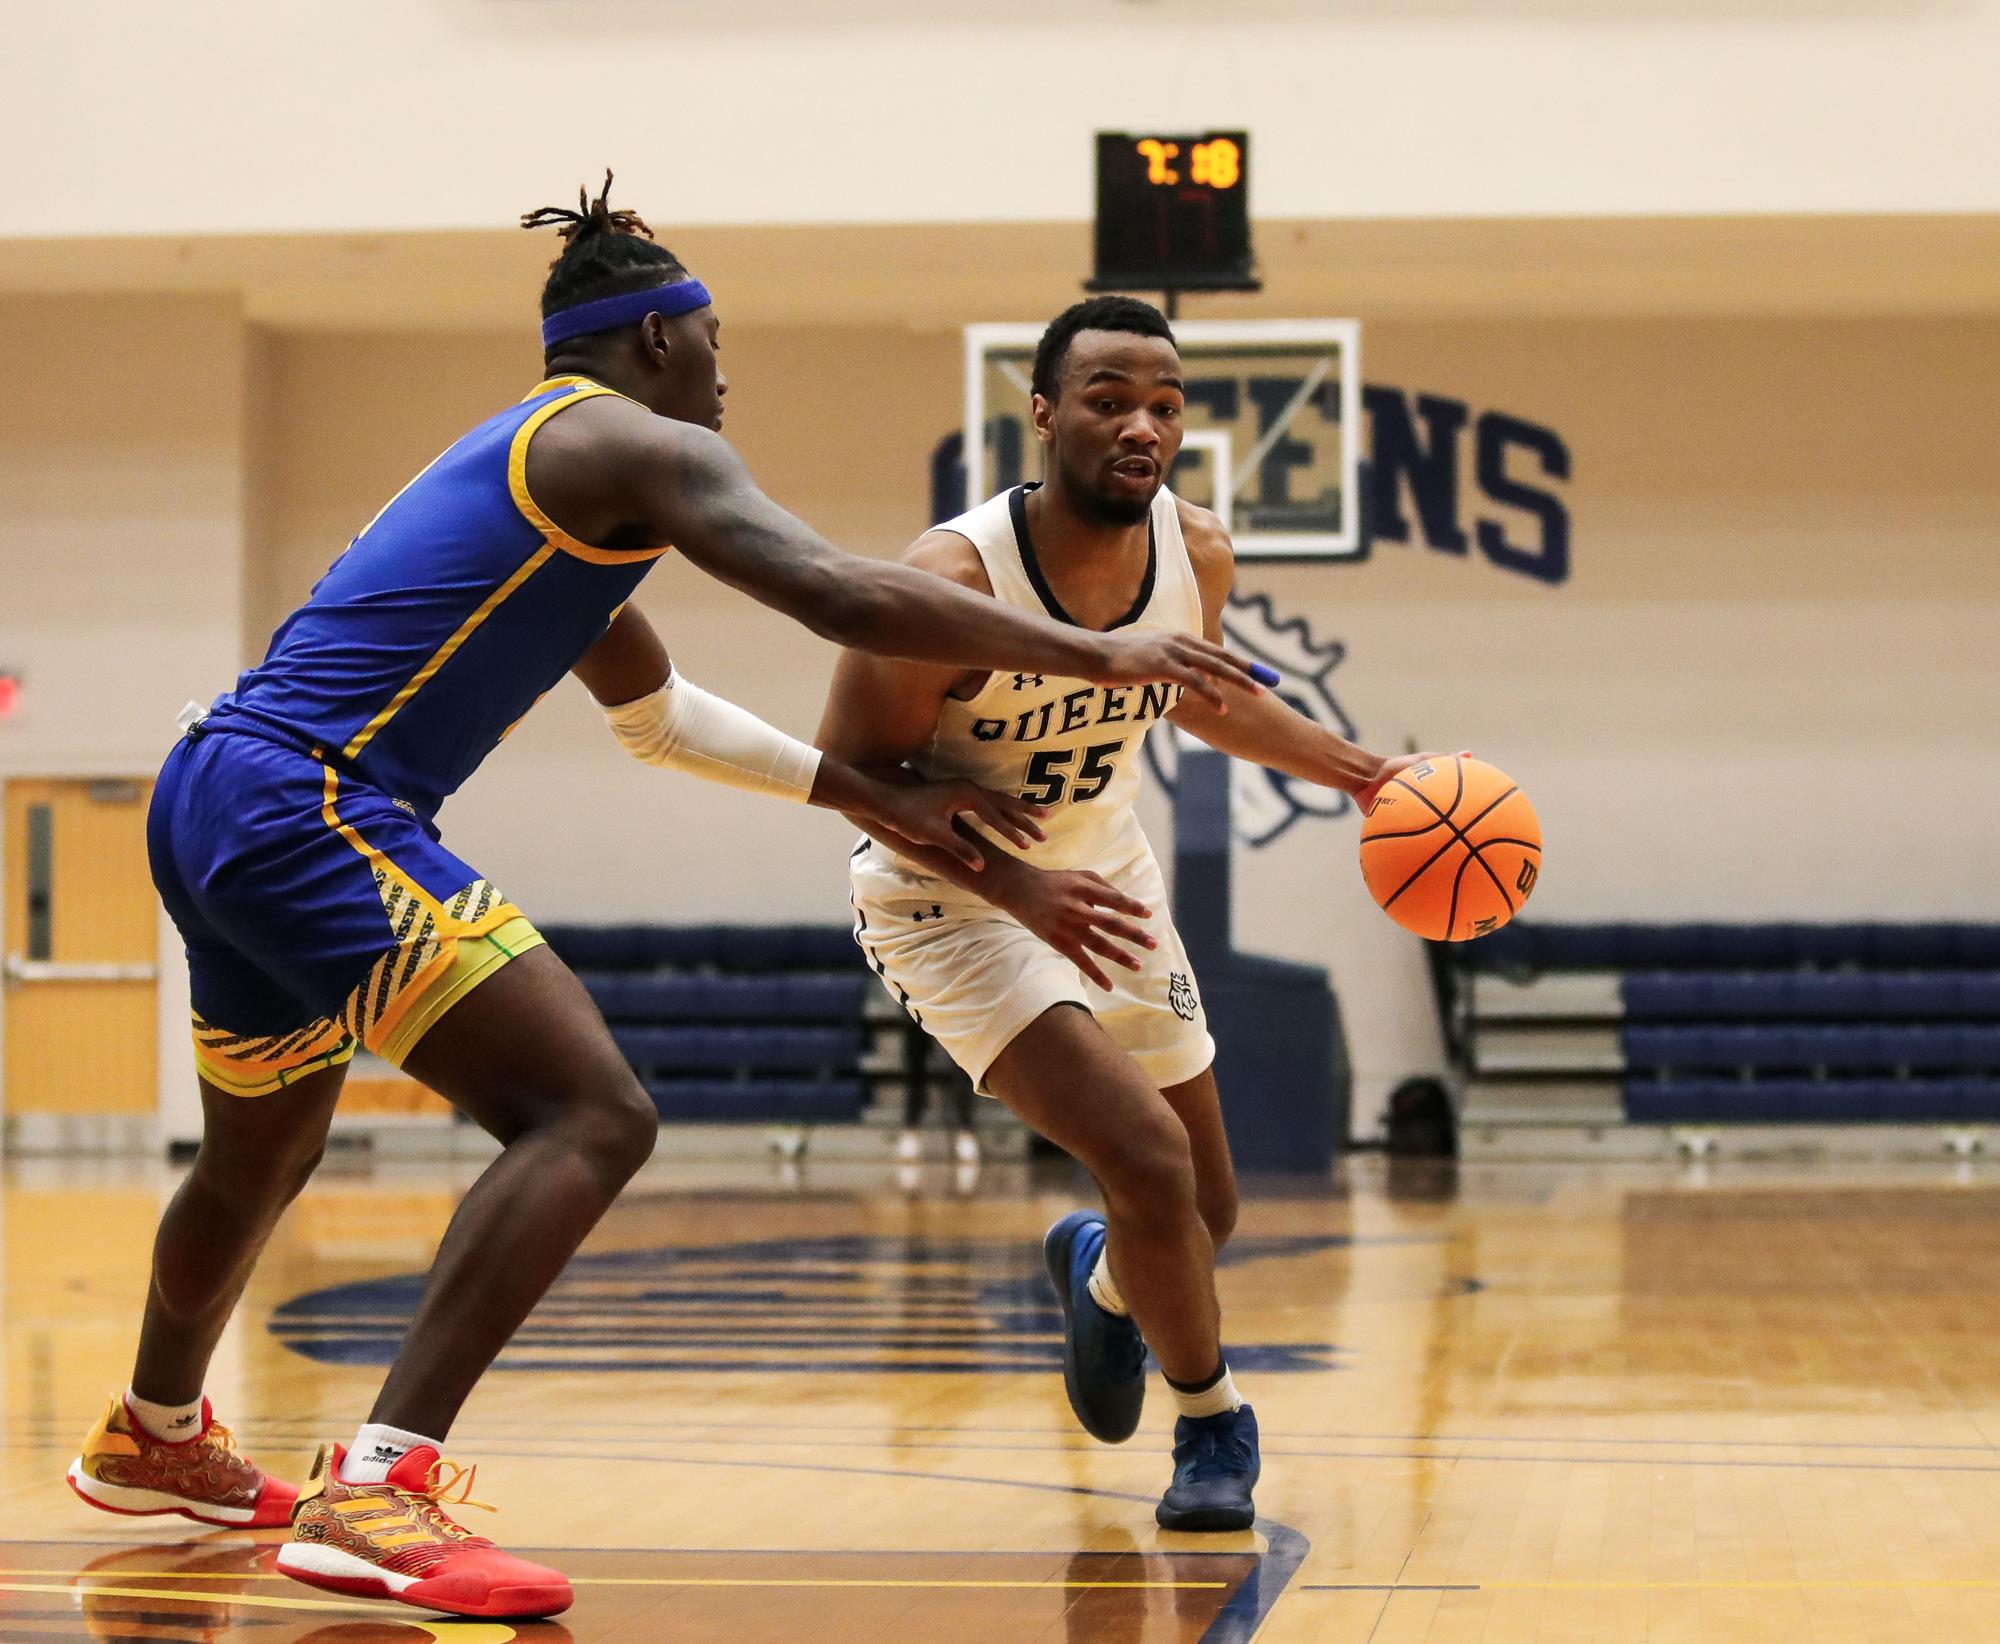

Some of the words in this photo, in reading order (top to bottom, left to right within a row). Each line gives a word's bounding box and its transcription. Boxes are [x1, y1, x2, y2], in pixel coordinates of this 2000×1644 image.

[930, 376, 1572, 584] QENS
[971, 683, 1184, 742] QUEEN
[1019, 737, 1129, 807] 55
[362, 1455, 394, 1465] adida
